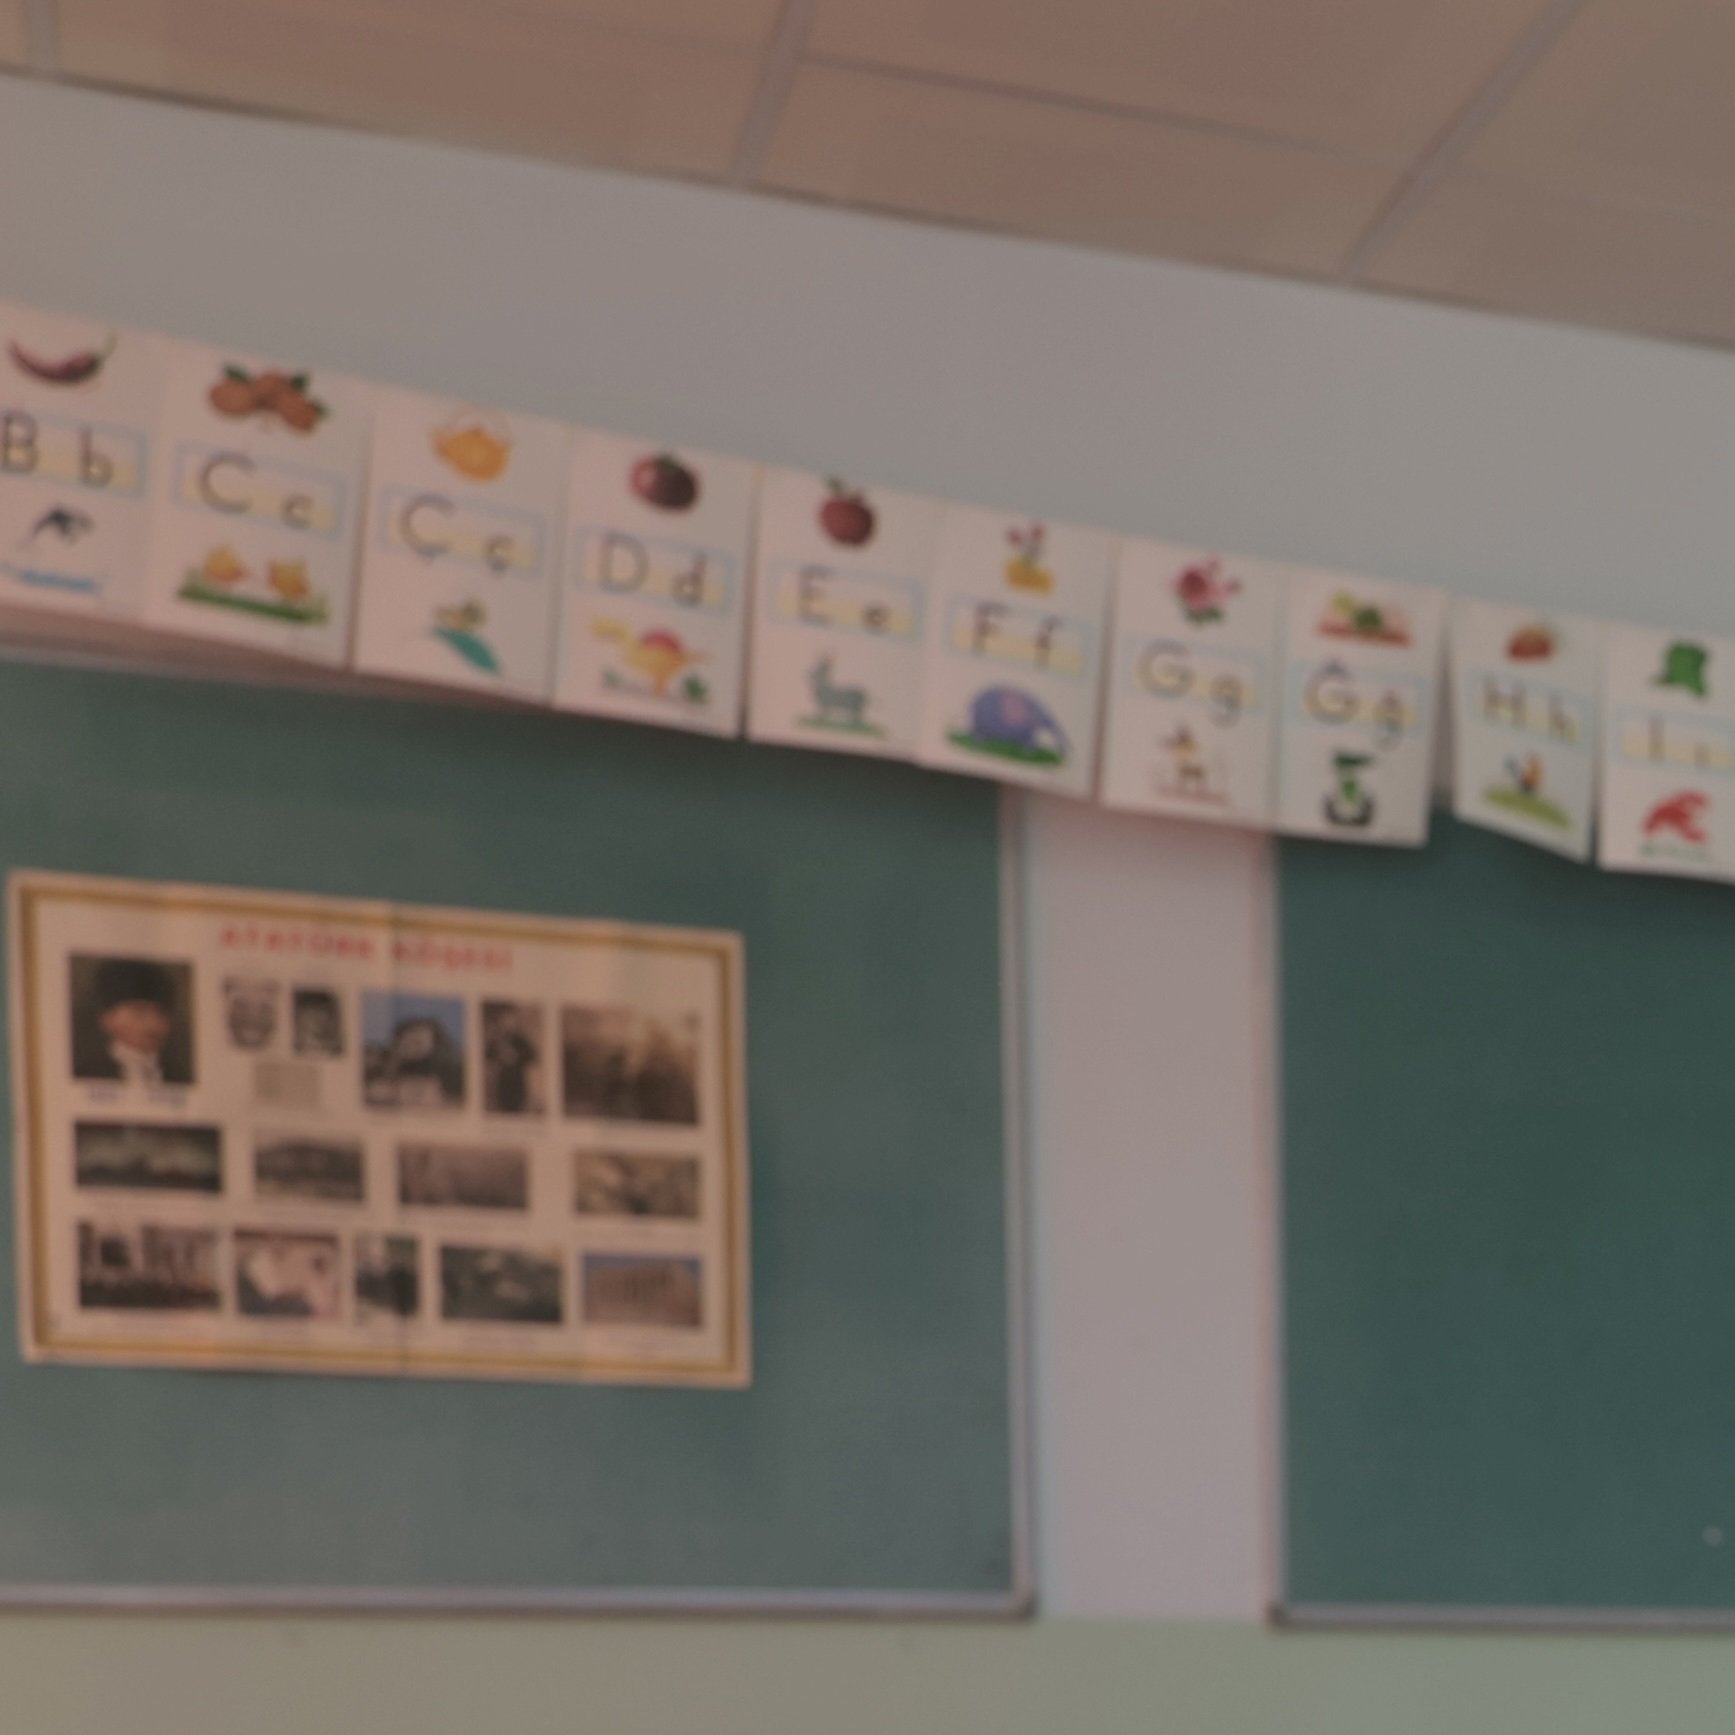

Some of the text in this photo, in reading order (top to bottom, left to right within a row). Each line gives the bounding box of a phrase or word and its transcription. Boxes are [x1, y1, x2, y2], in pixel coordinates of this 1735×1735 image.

[3, 411, 113, 488] B b
[600, 530, 706, 606] D d
